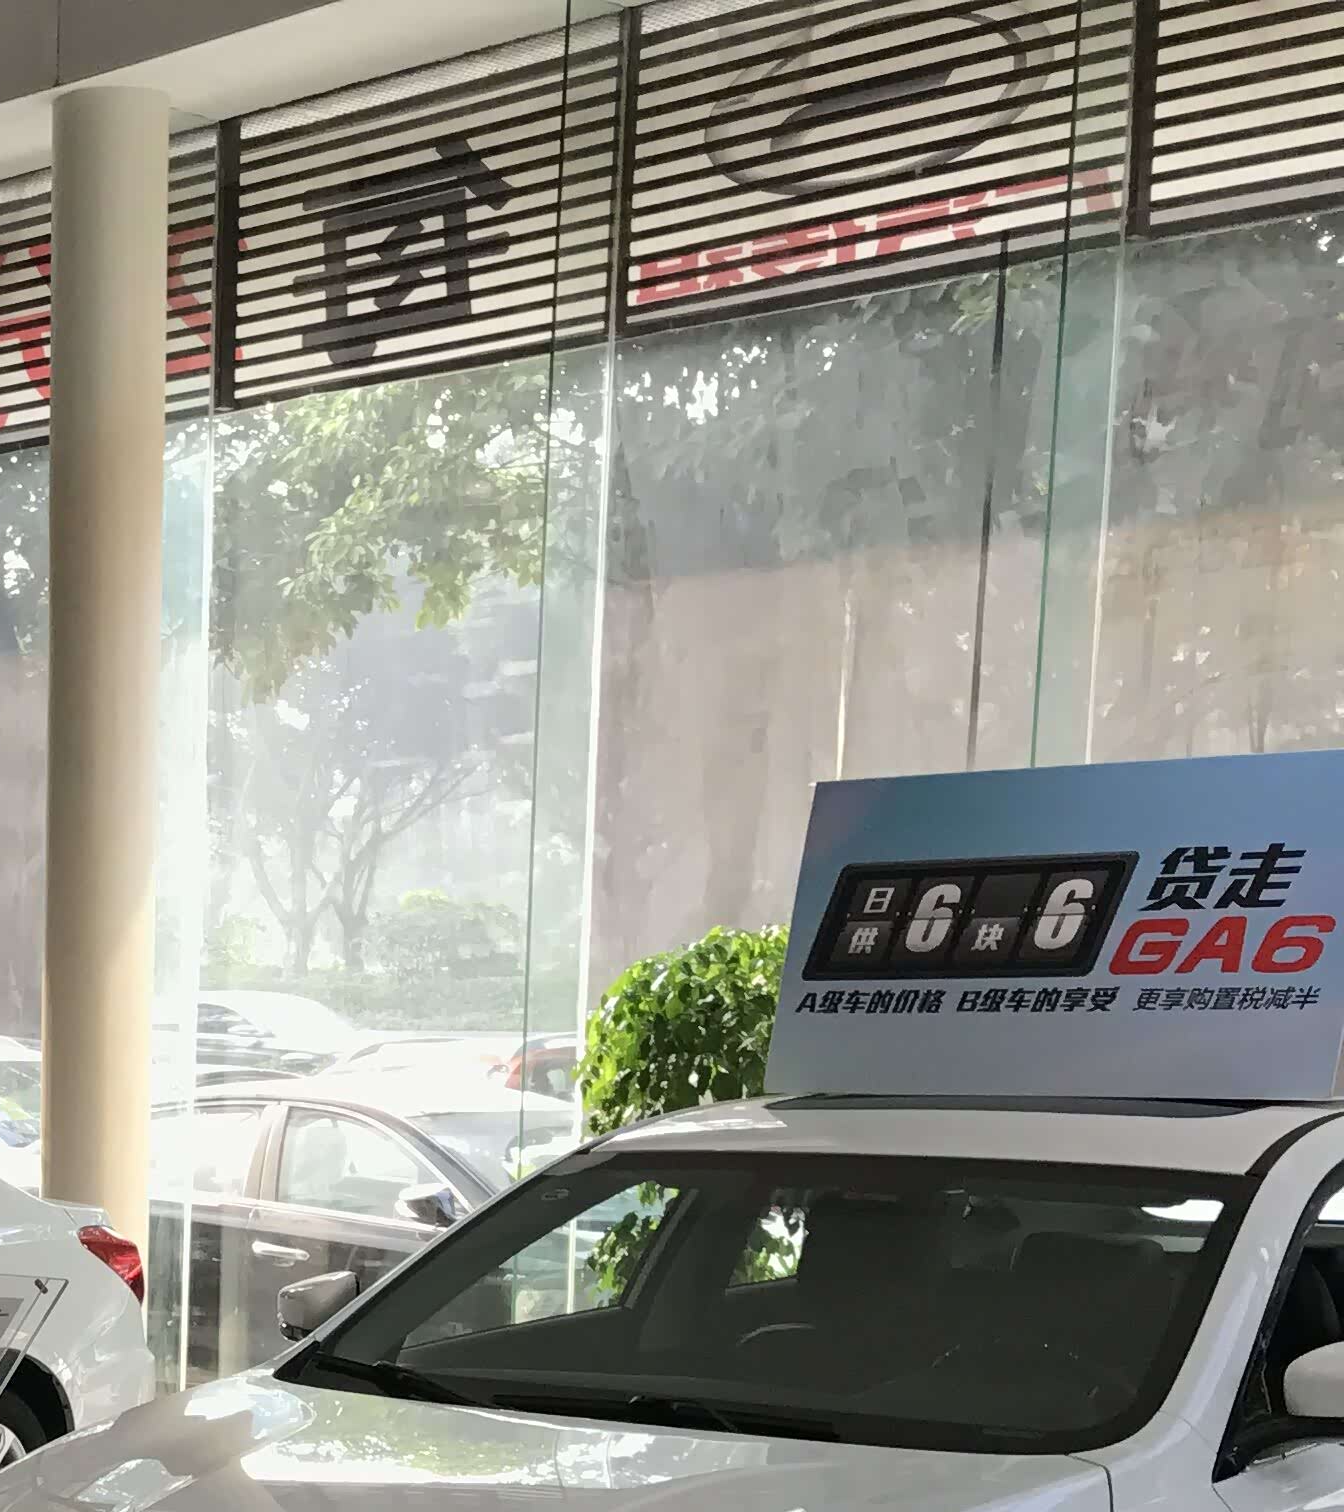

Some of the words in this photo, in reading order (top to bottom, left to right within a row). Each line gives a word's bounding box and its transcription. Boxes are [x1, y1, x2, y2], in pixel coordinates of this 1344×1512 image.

[1138, 842, 1307, 911] 贷走
[1108, 915, 1337, 975] GA6
[1133, 985, 1321, 1012] 更享购置税减半
